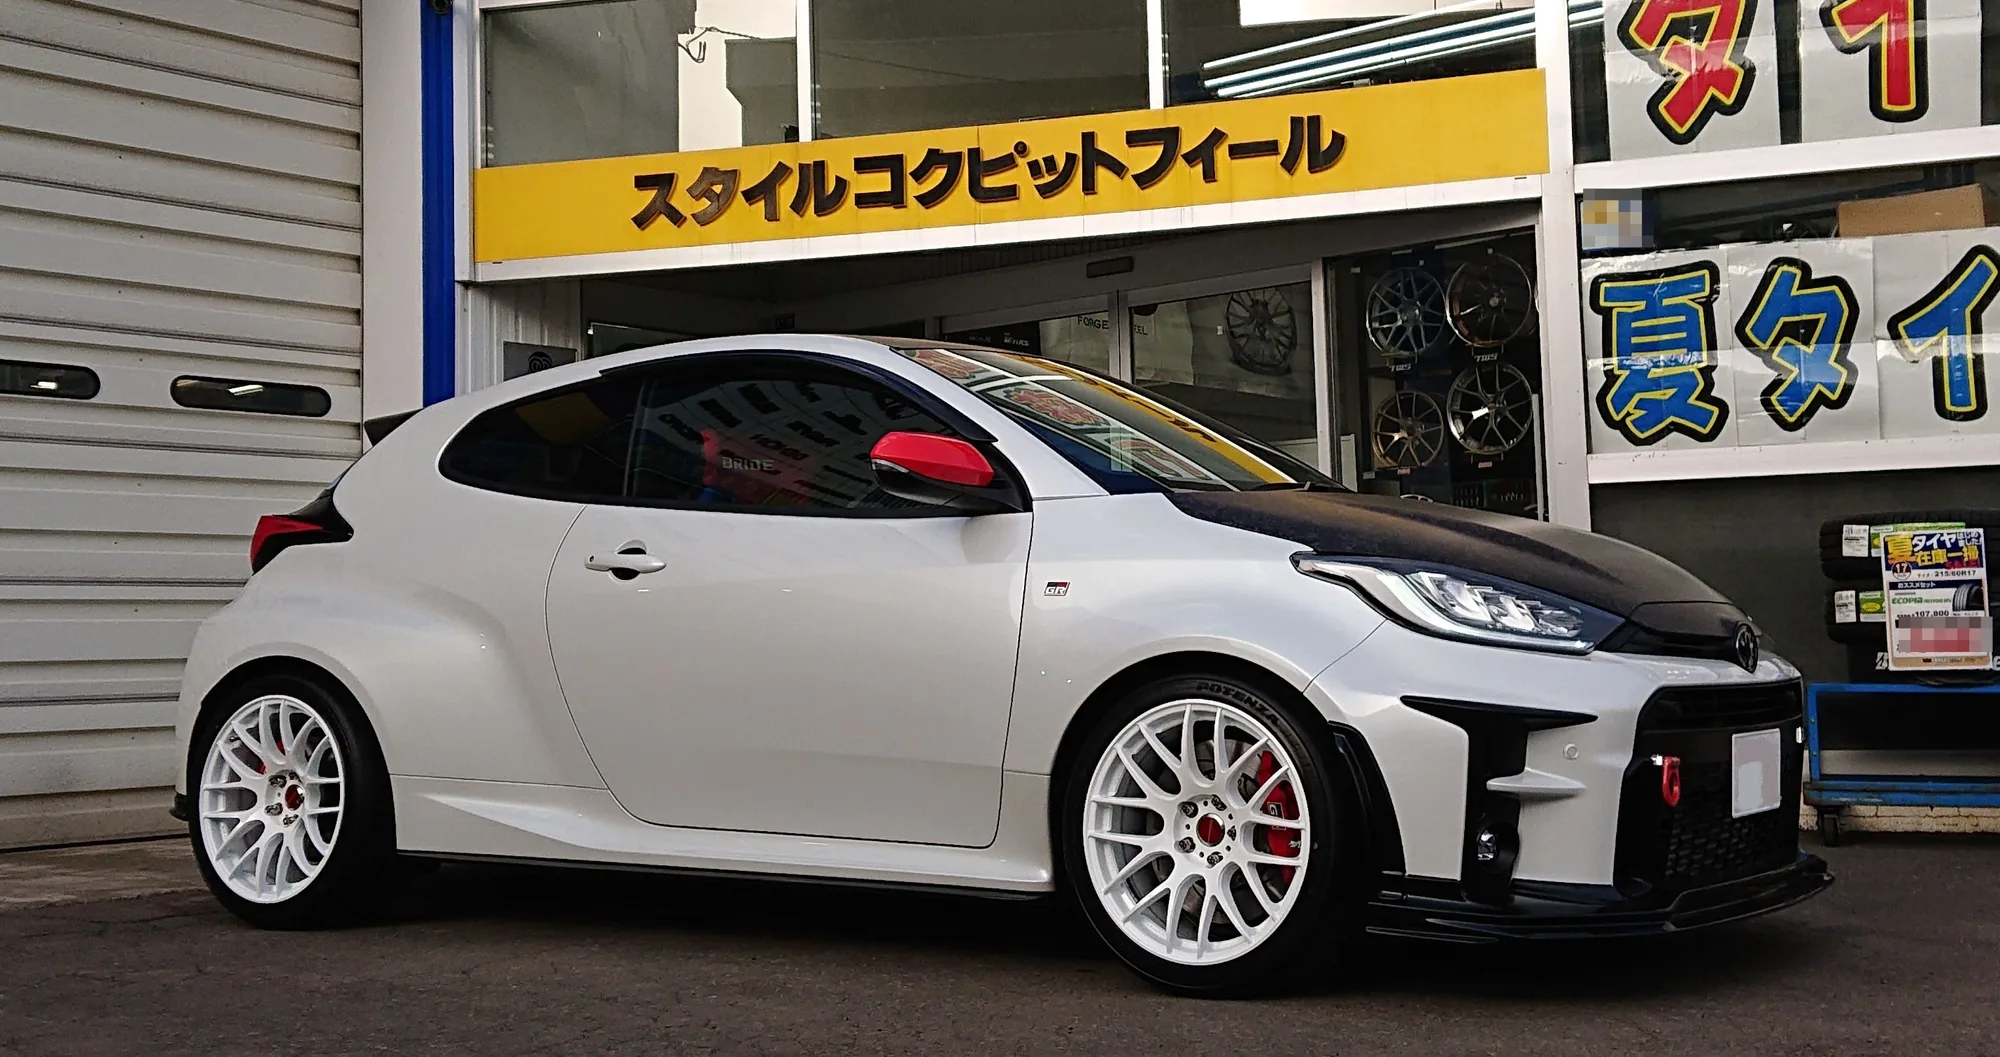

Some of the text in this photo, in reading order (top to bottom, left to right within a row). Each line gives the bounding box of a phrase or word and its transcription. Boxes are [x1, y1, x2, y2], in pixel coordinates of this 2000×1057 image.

[630, 115, 1346, 231] スタイルコクピットフィール
[1589, 245, 2000, 446] 夏タイ
[721, 456, 774, 471] BRIDE
[1895, 562, 1908, 573] 17
[1045, 586, 1066, 595] GR
[1196, 681, 1280, 727] POTENZA
